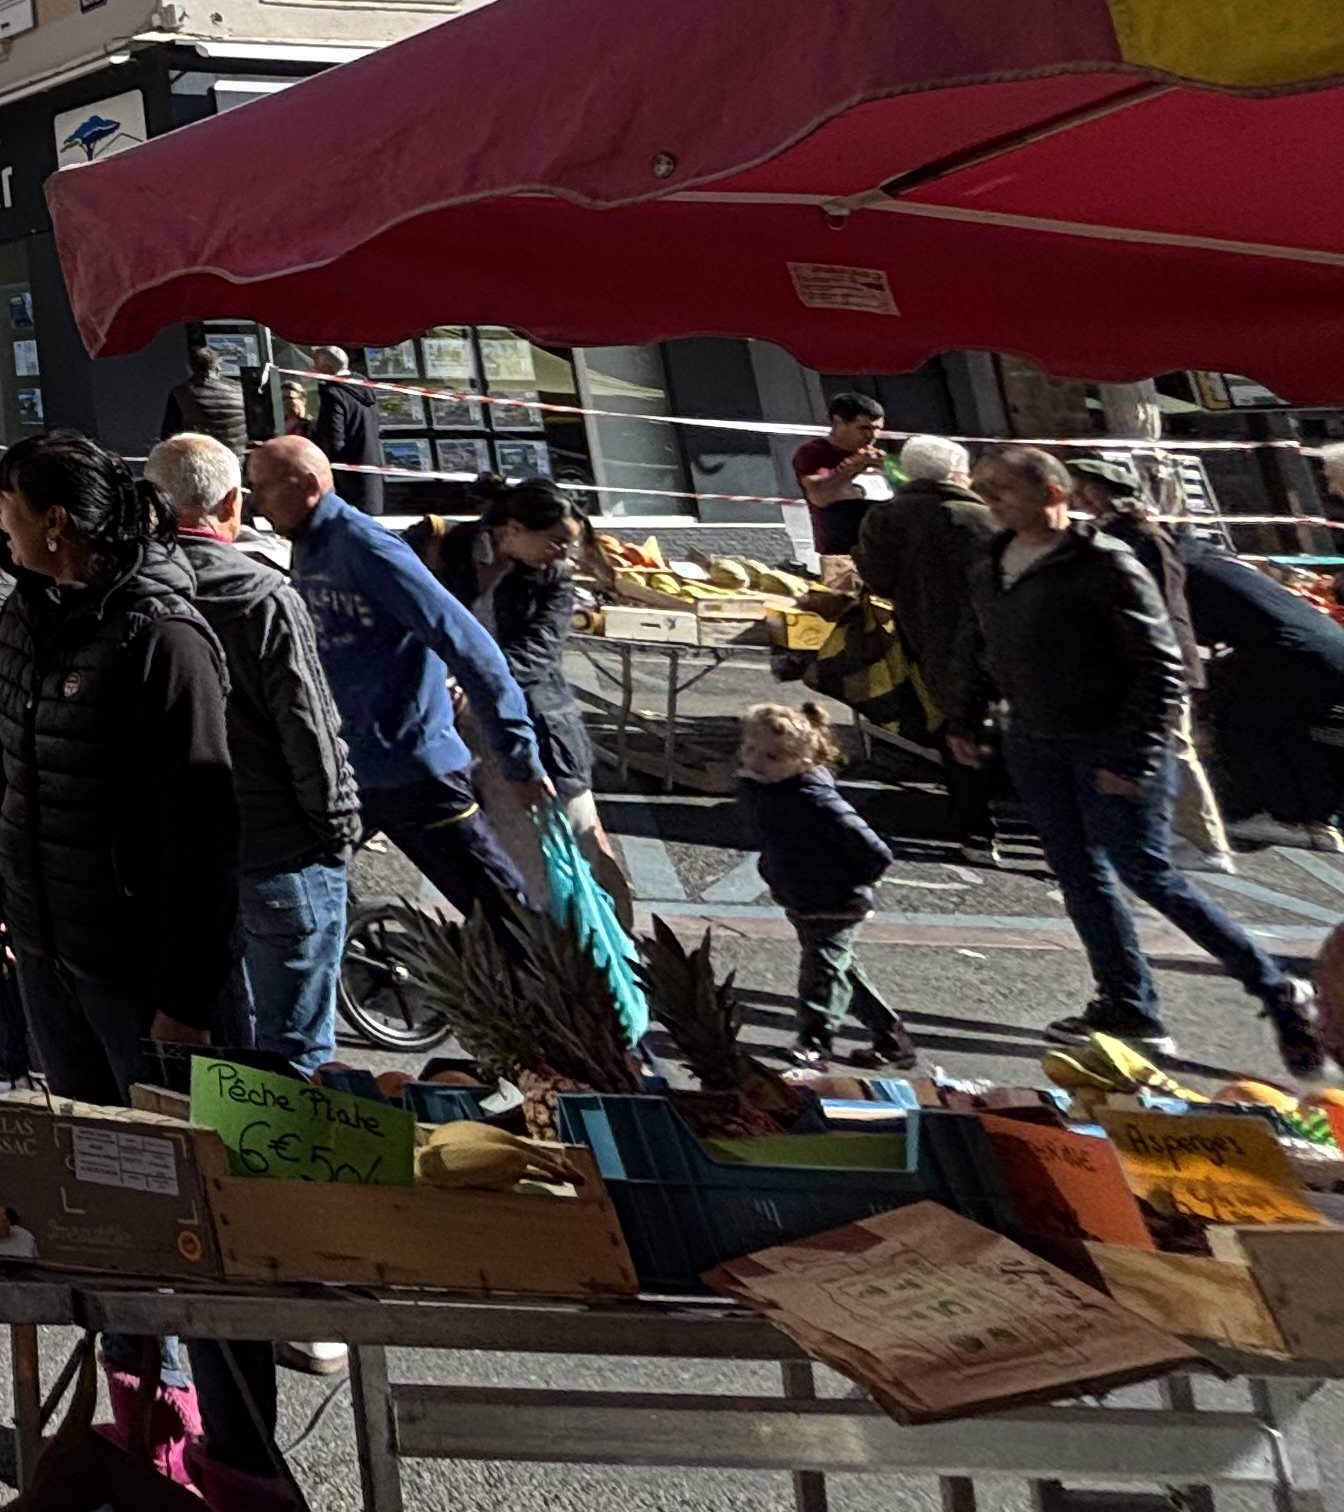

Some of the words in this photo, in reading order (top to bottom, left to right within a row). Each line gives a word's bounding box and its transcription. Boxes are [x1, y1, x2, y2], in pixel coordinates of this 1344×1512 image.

[208, 1063, 295, 1112] Pêche
[299, 1088, 385, 1137] Plate
[1126, 1123, 1247, 1171] Asperges
